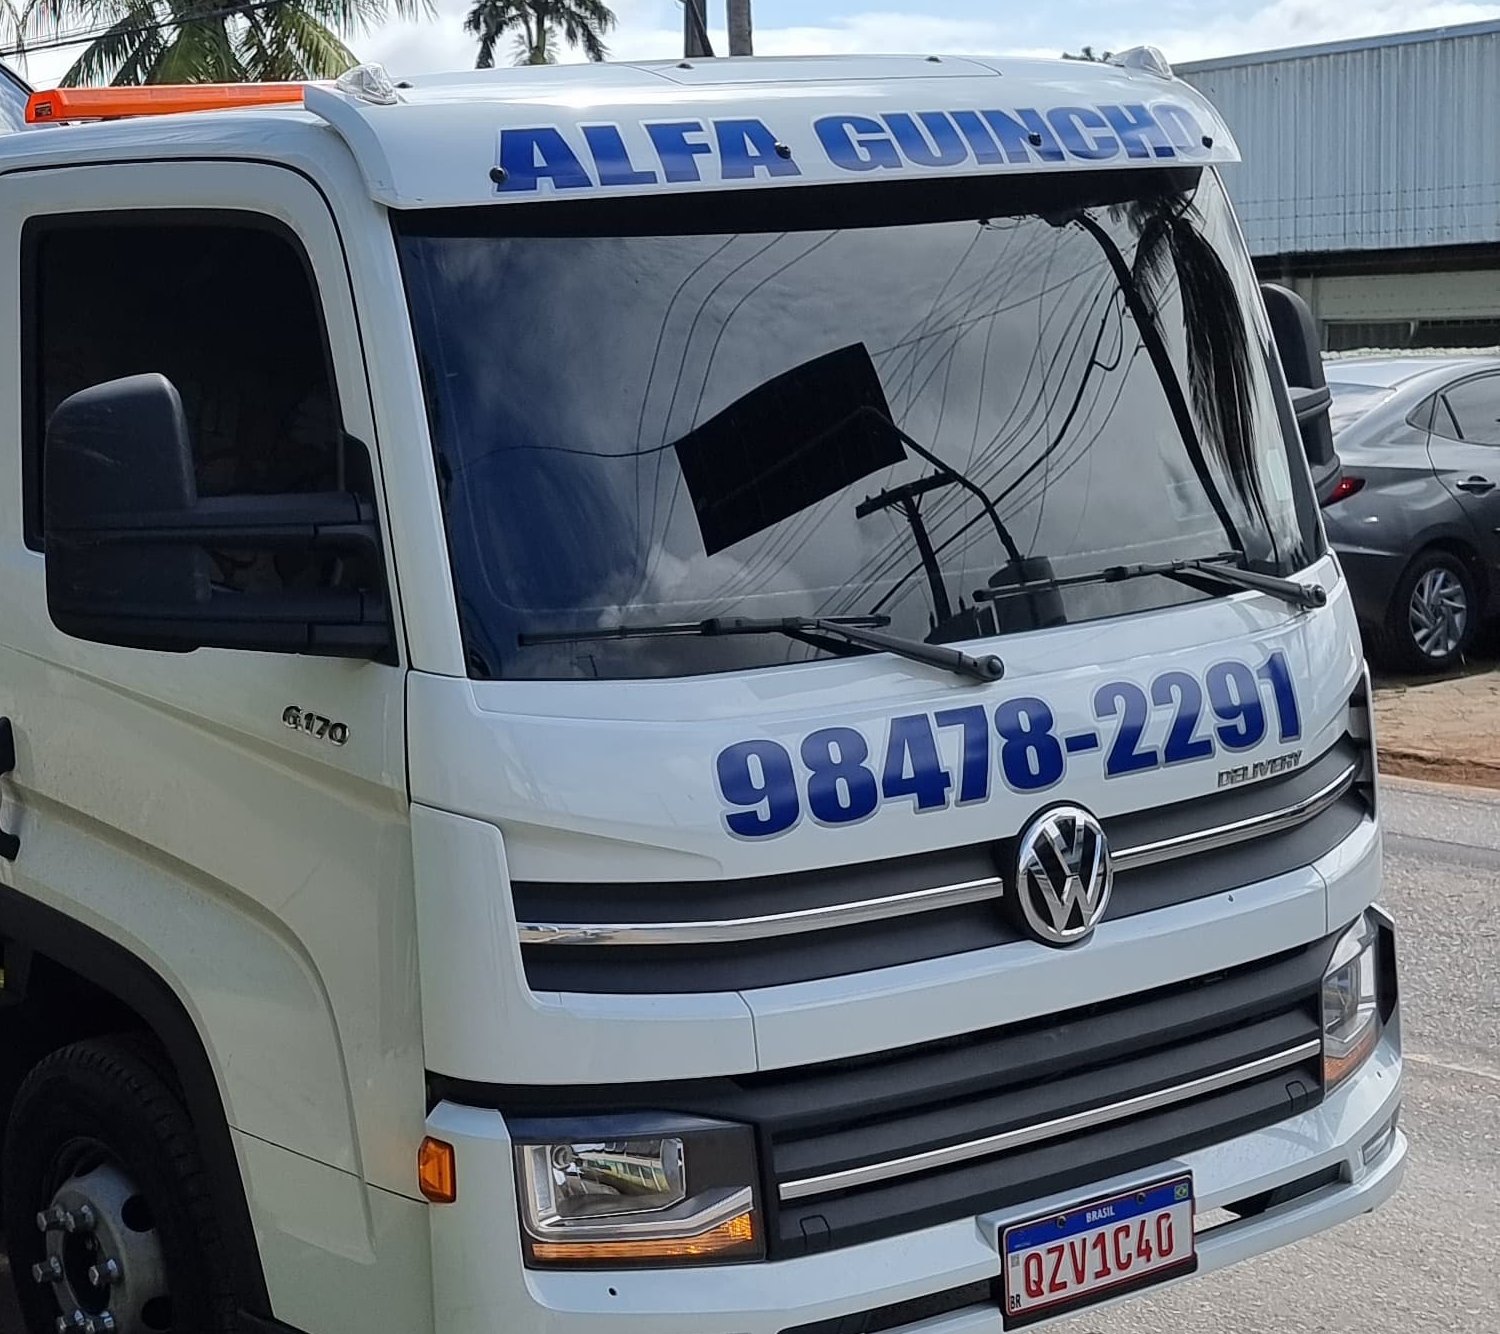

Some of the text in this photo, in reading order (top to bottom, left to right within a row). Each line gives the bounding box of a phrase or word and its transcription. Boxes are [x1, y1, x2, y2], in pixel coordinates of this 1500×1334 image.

[495, 103, 1203, 194] ALFA GUINCHO
[715, 648, 1302, 842] 98478-2291
[1217, 749, 1303, 788] DELIVERY
[1085, 1205, 1116, 1224] BRASIL
[1023, 1212, 1175, 1299] QZV1C40
[1010, 1293, 1022, 1310] BR
